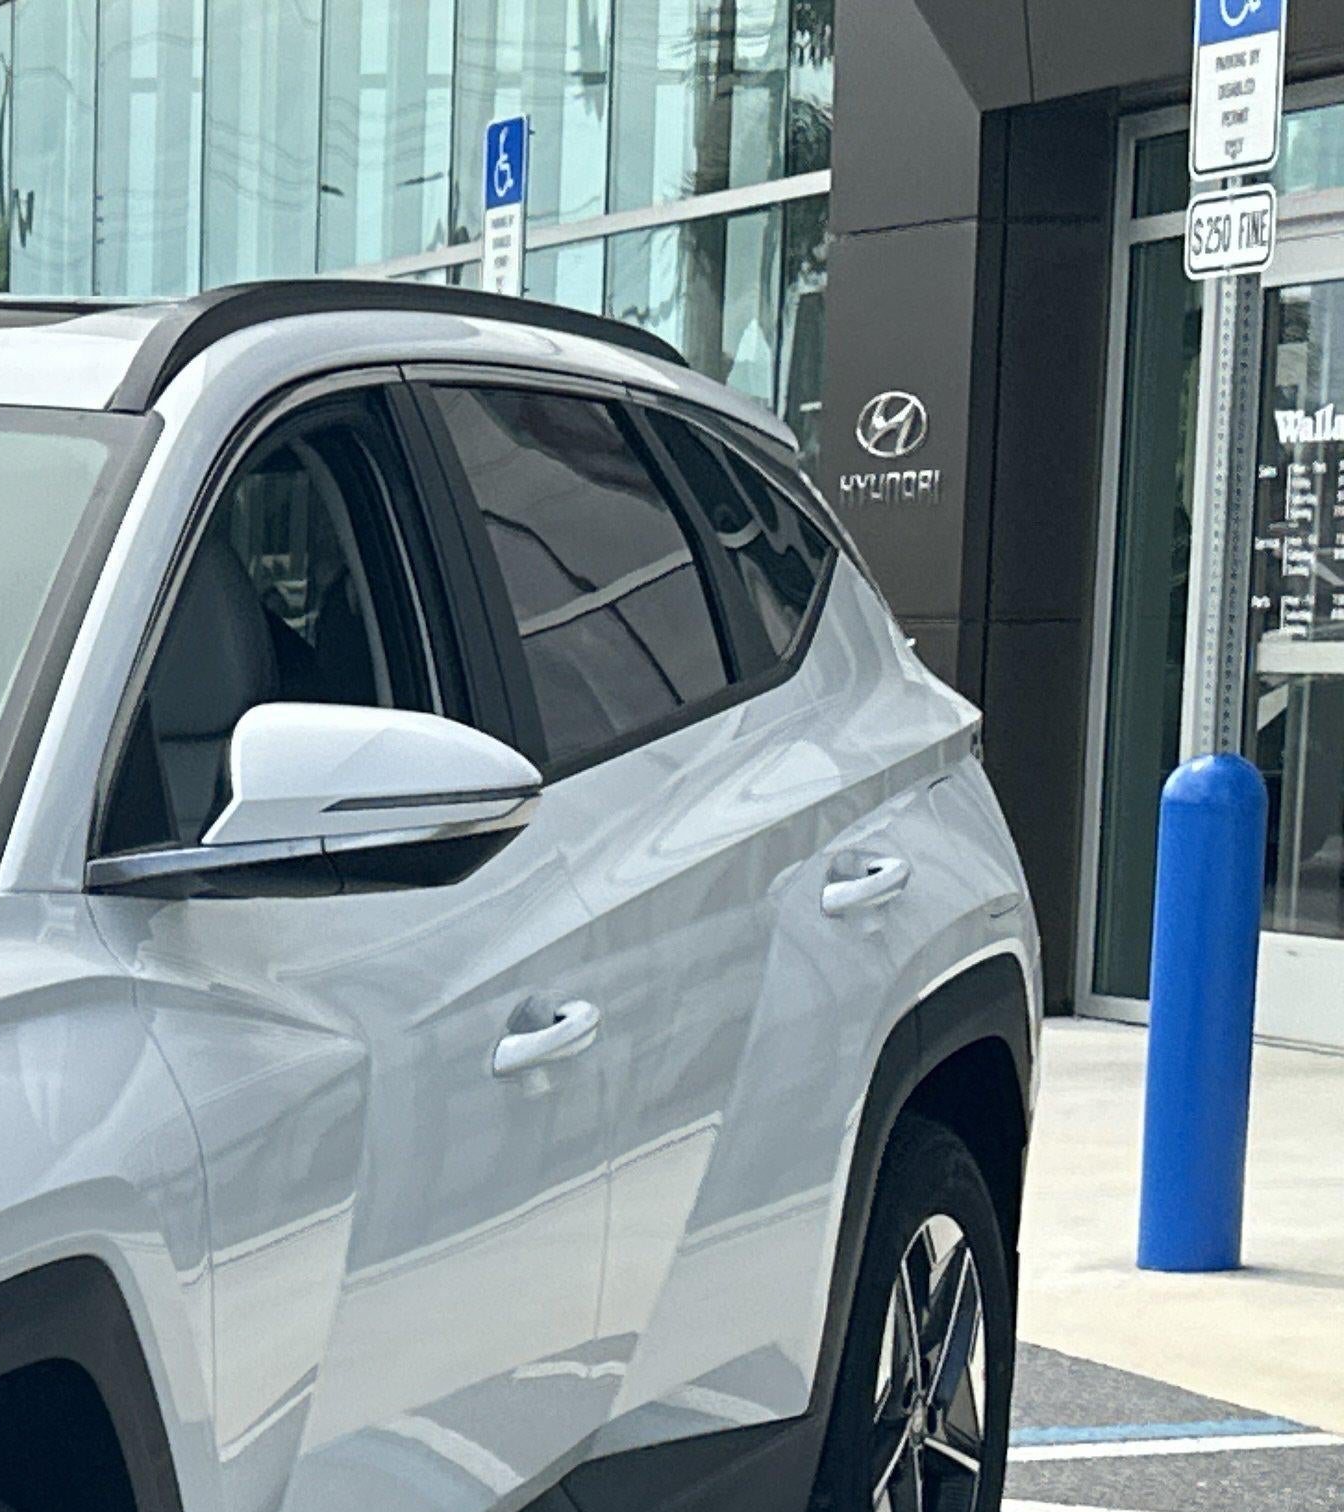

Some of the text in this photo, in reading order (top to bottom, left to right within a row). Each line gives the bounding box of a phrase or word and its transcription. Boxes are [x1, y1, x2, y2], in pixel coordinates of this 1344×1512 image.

[1192, 208, 1269, 256] $250 FINE
[840, 468, 941, 503] HYUNDAI
